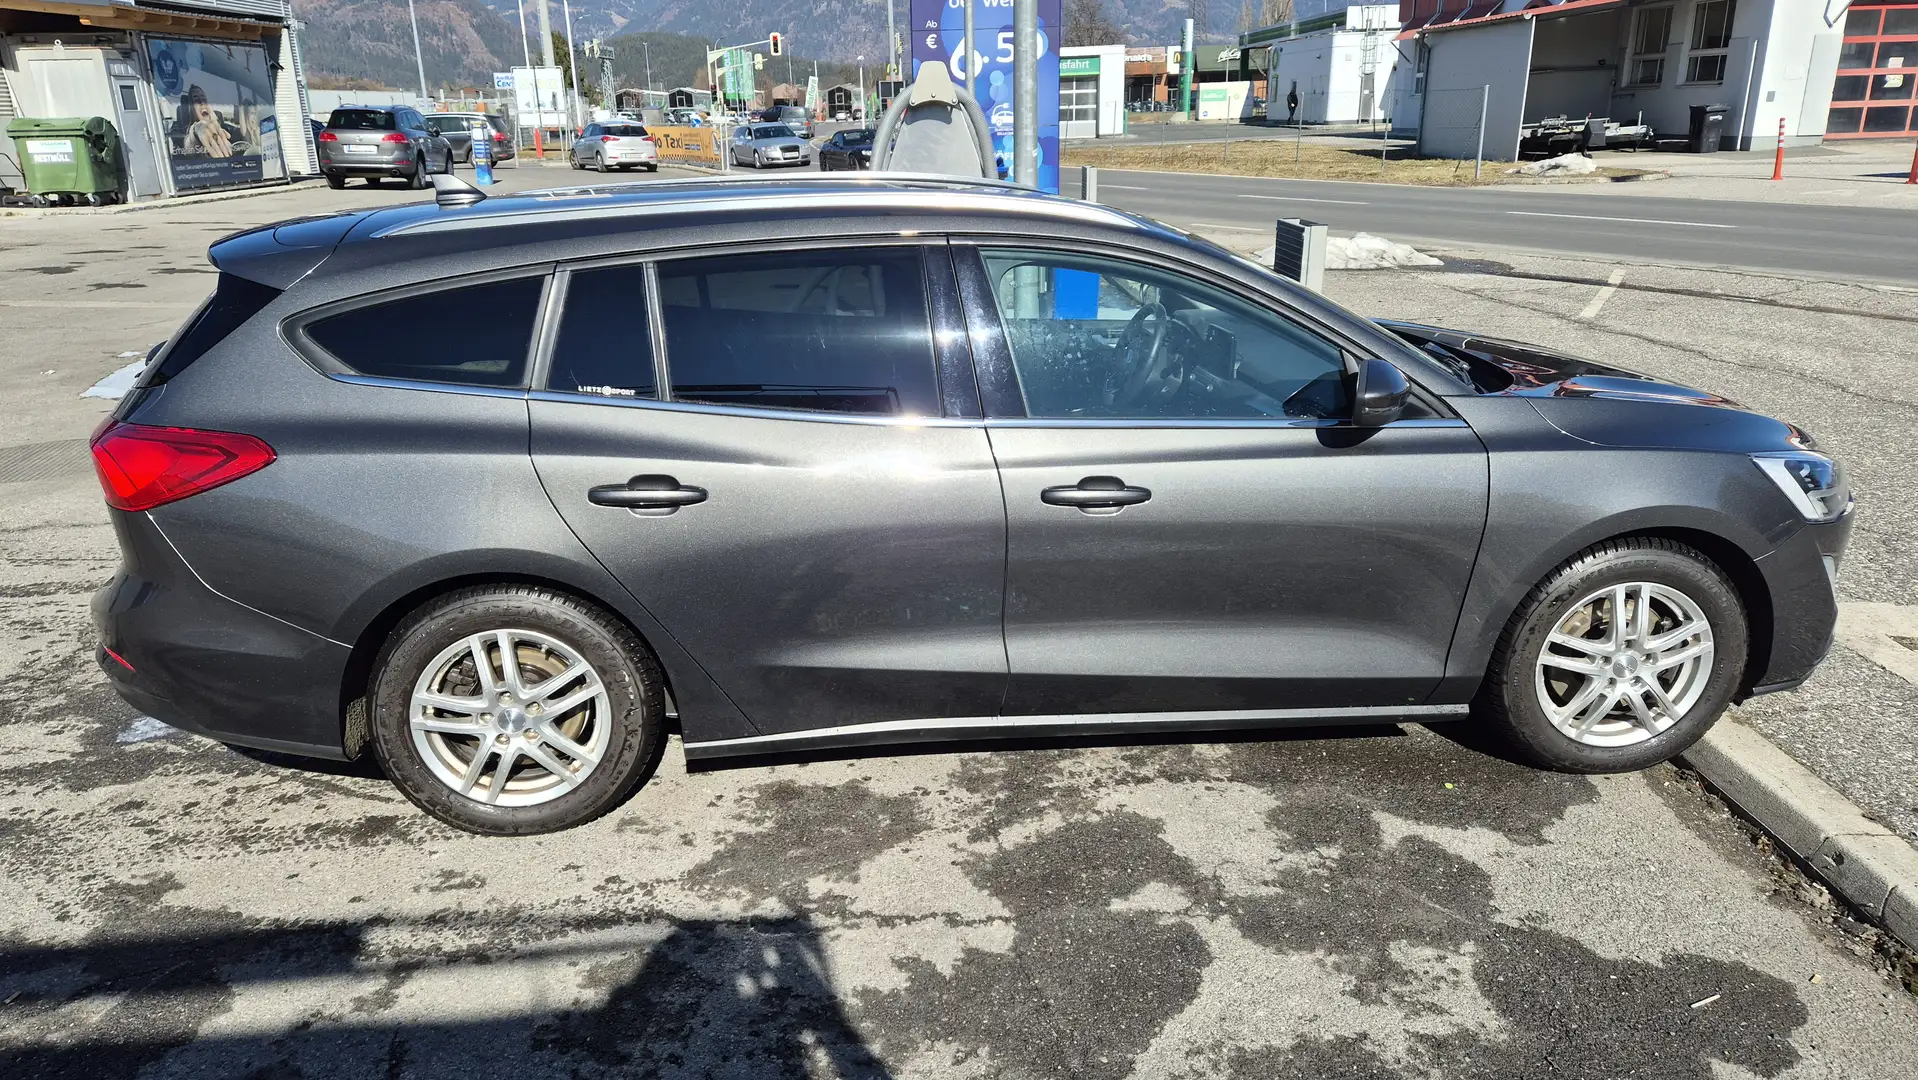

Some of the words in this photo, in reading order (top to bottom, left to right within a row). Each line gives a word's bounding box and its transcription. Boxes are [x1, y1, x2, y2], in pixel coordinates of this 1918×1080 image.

[925, 20, 938, 28] Ab
[925, 33, 938, 49] €
[663, 133, 684, 149] Taxi
[577, 385, 602, 393] LIETZ
[611, 388, 636, 396] SPORT
